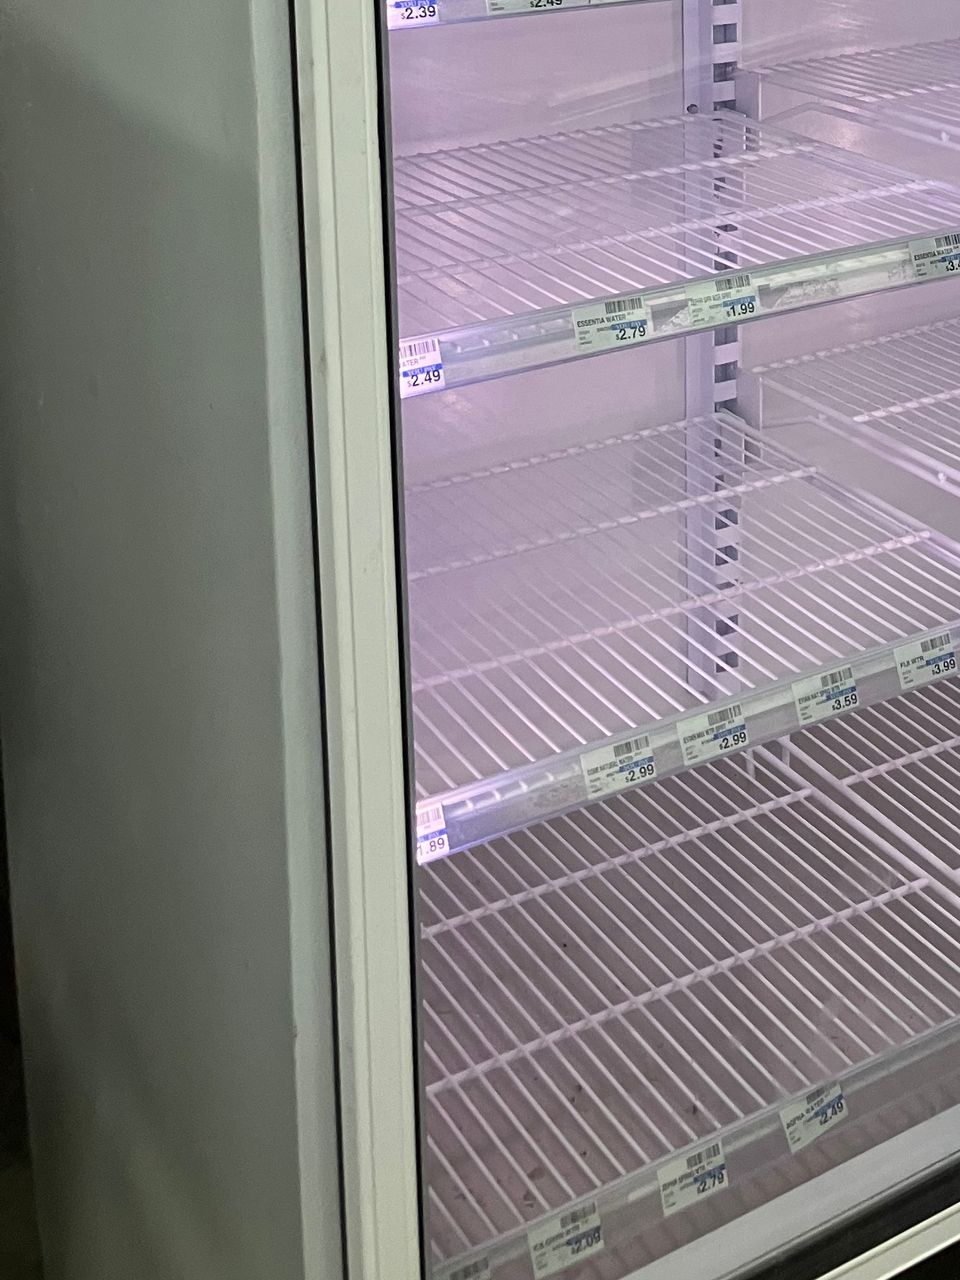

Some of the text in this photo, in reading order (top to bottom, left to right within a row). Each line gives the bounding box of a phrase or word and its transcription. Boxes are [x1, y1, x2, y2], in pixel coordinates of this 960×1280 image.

[400, 5, 436, 20] $2.39
[726, 301, 755, 317] $1.99
[576, 313, 627, 328] ESSENTIA WATER
[615, 325, 646, 341] $2.79
[407, 370, 441, 388] $2.49
[931, 658, 956, 675] $3.99
[831, 693, 858, 711] $3.59
[719, 731, 747, 751] $2.99
[624, 763, 655, 783] $2.99
